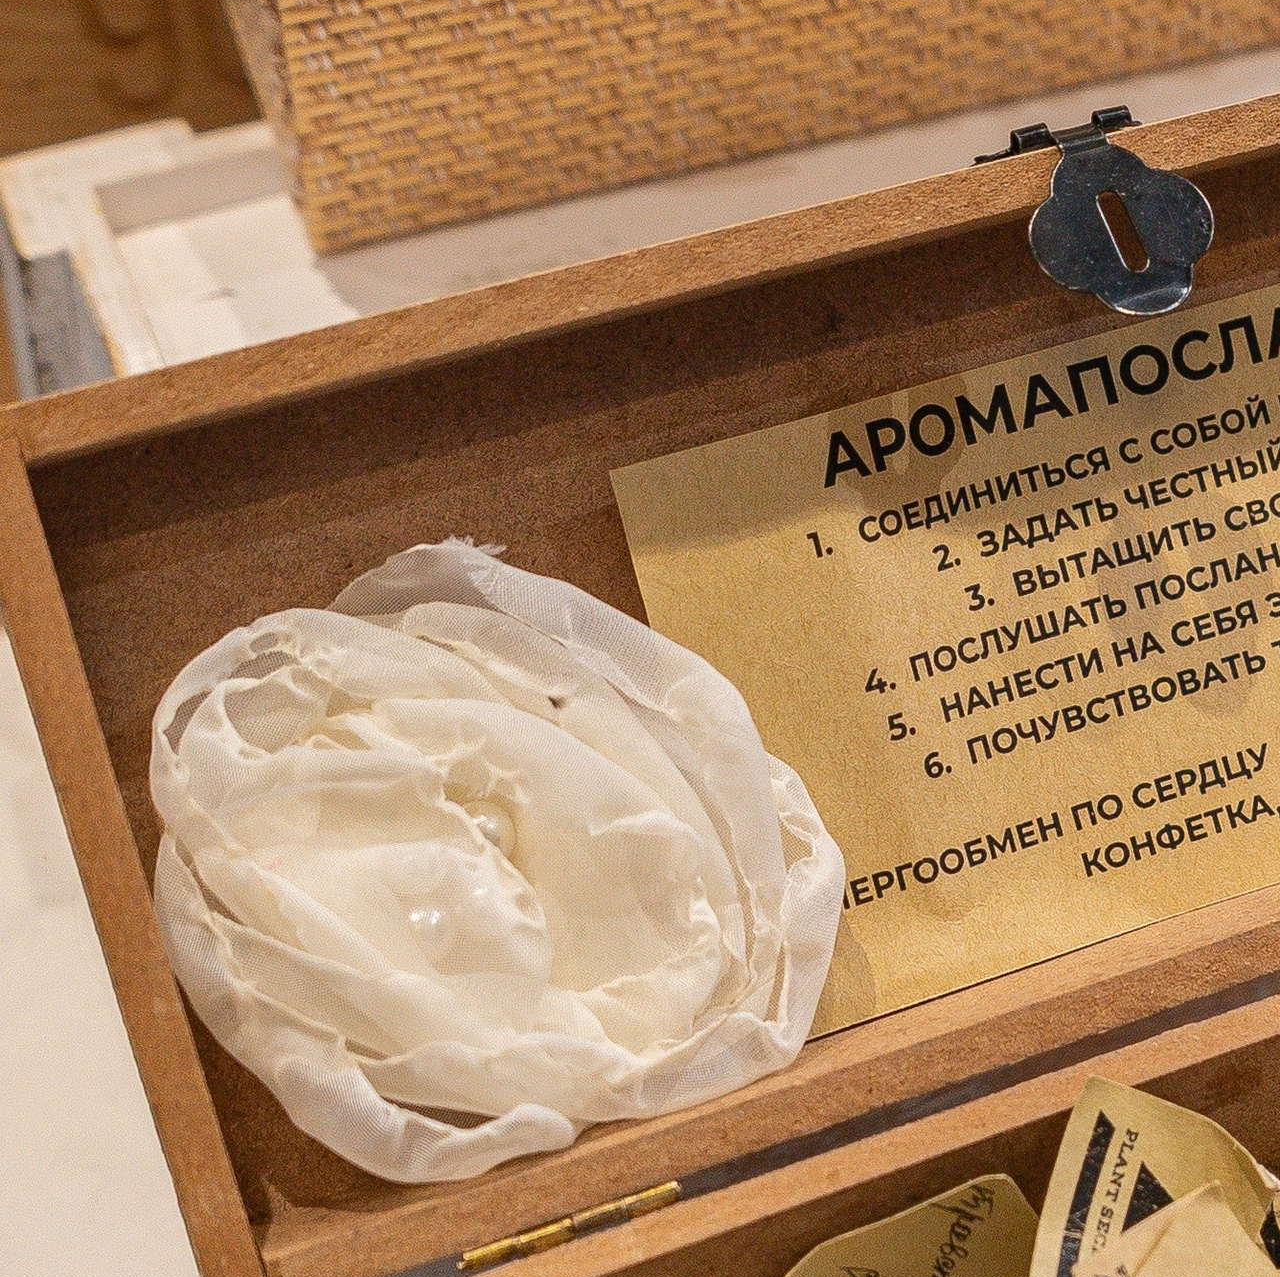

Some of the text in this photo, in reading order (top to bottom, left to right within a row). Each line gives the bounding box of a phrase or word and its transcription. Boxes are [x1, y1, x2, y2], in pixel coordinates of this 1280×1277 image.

[806, 532, 834, 558] 1.
[858, 446, 1111, 543] СОЕДИНИТЬСЯ
[1119, 437, 1143, 464] С
[1150, 394, 1271, 455] СОБОЙ
[932, 544, 961, 572] 2.
[977, 497, 1119, 557] ЗАДАТЬ
[964, 583, 995, 612] 3.
[1012, 517, 1217, 597] ВЫТАЩИТЬ
[865, 668, 897, 694] 4.
[909, 594, 1127, 682] ПОСЛУШАТЬ
[888, 712, 916, 741] 5.
[940, 648, 1104, 723] НАНЕСТИ
[1111, 631, 1165, 667] НА
[1171, 599, 1259, 647] СЕБЯ
[924, 751, 952, 779] 6.
[966, 650, 1266, 765] ПОЧУВСТВОВАТЬ
[1071, 794, 1123, 831] ПО
[1132, 743, 1267, 809] СЕРДЦУ
[1104, 1128, 1139, 1203] PLANT
